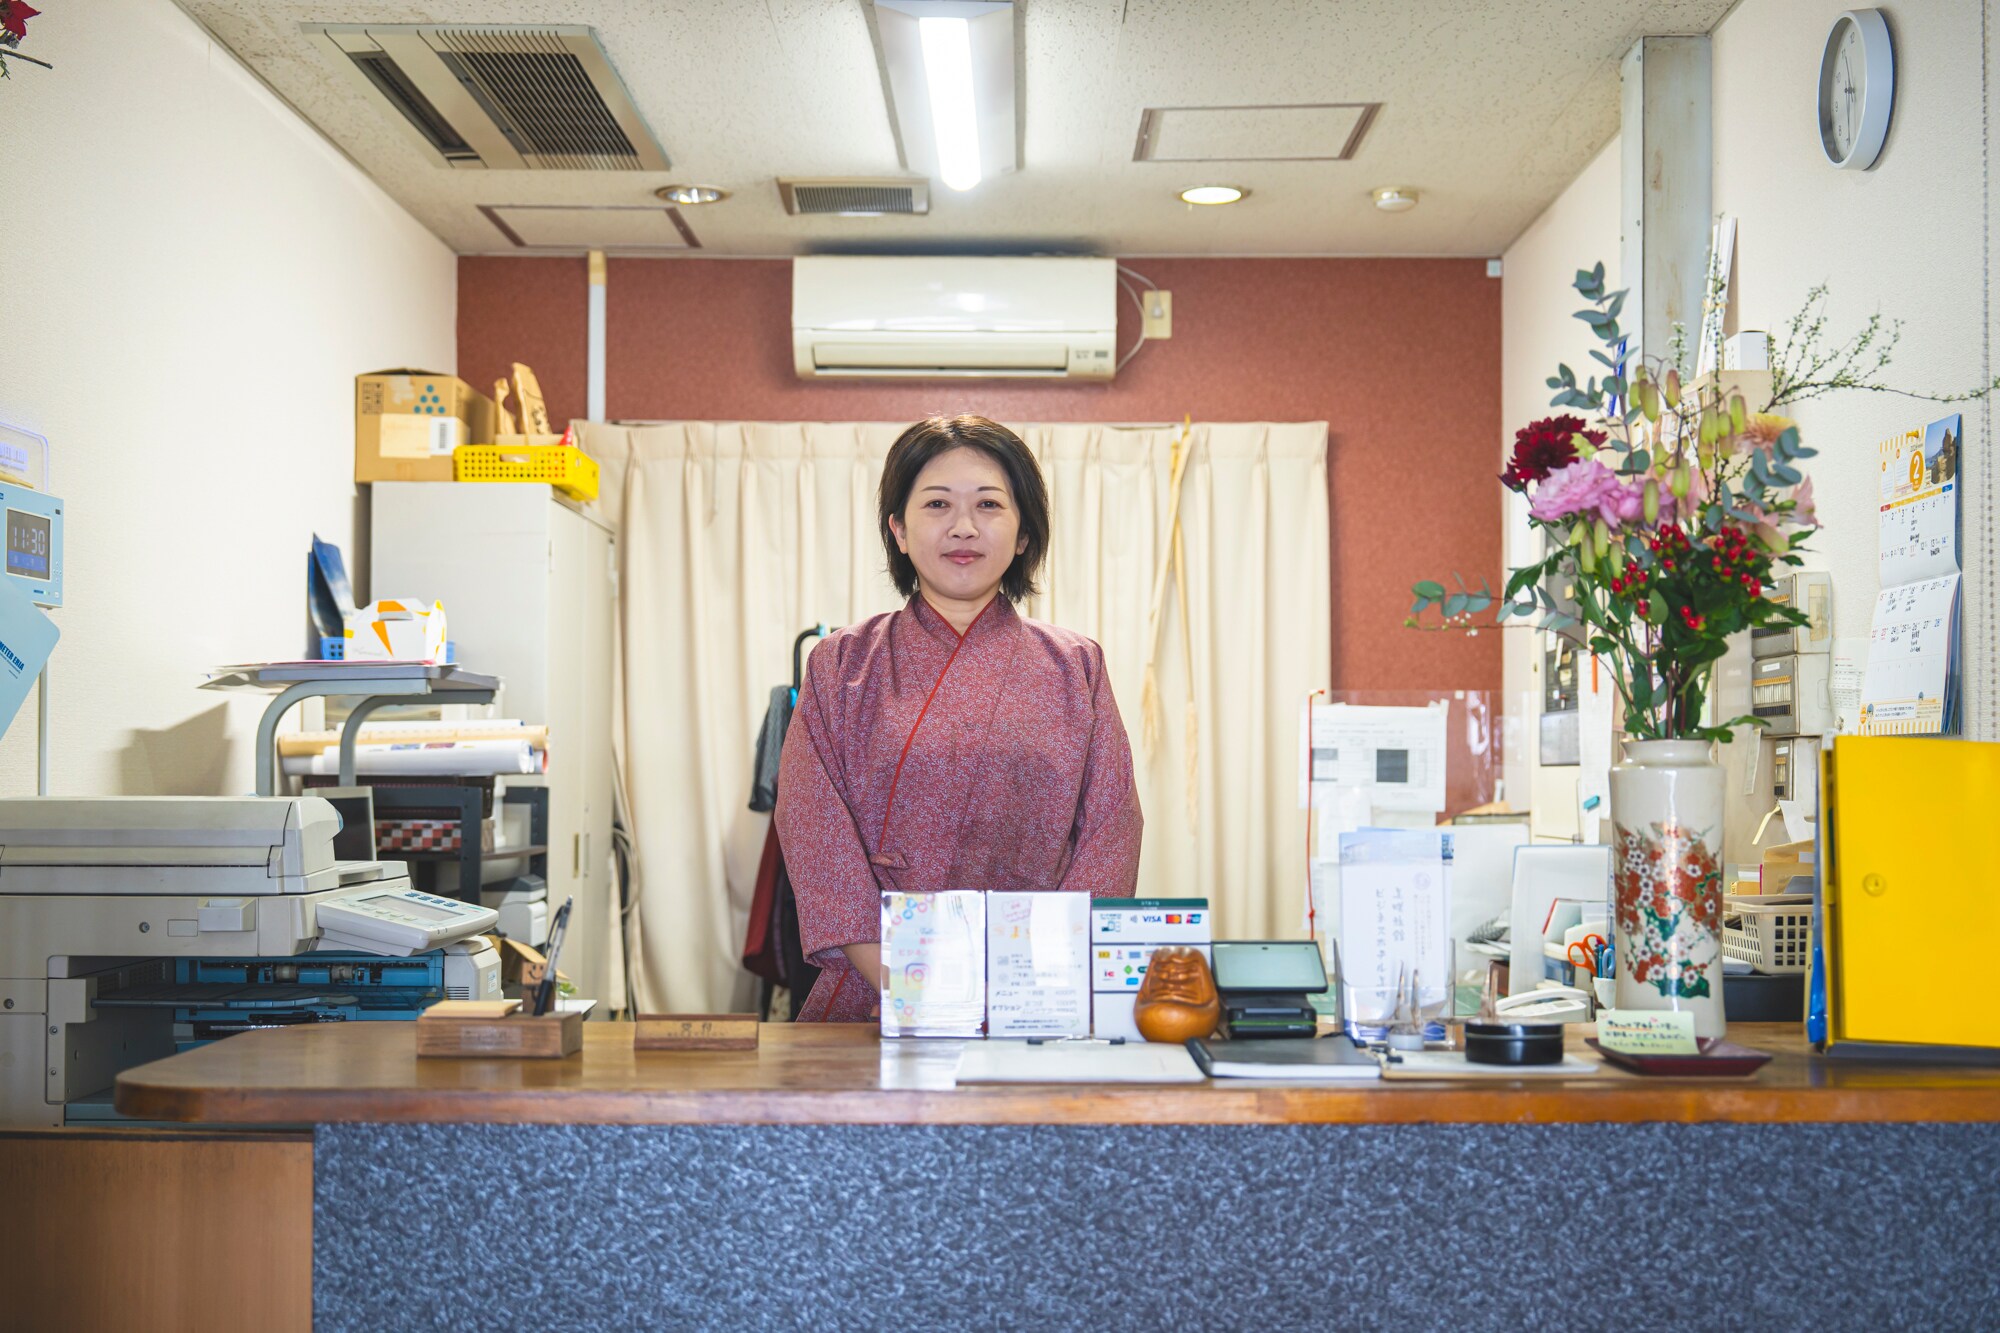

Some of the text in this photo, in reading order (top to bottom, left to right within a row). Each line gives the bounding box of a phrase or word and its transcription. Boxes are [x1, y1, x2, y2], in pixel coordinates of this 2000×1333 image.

[1913, 454, 1920, 480] 2
[14, 527, 46, 556] 11:30
[1143, 915, 1162, 923] VISA
